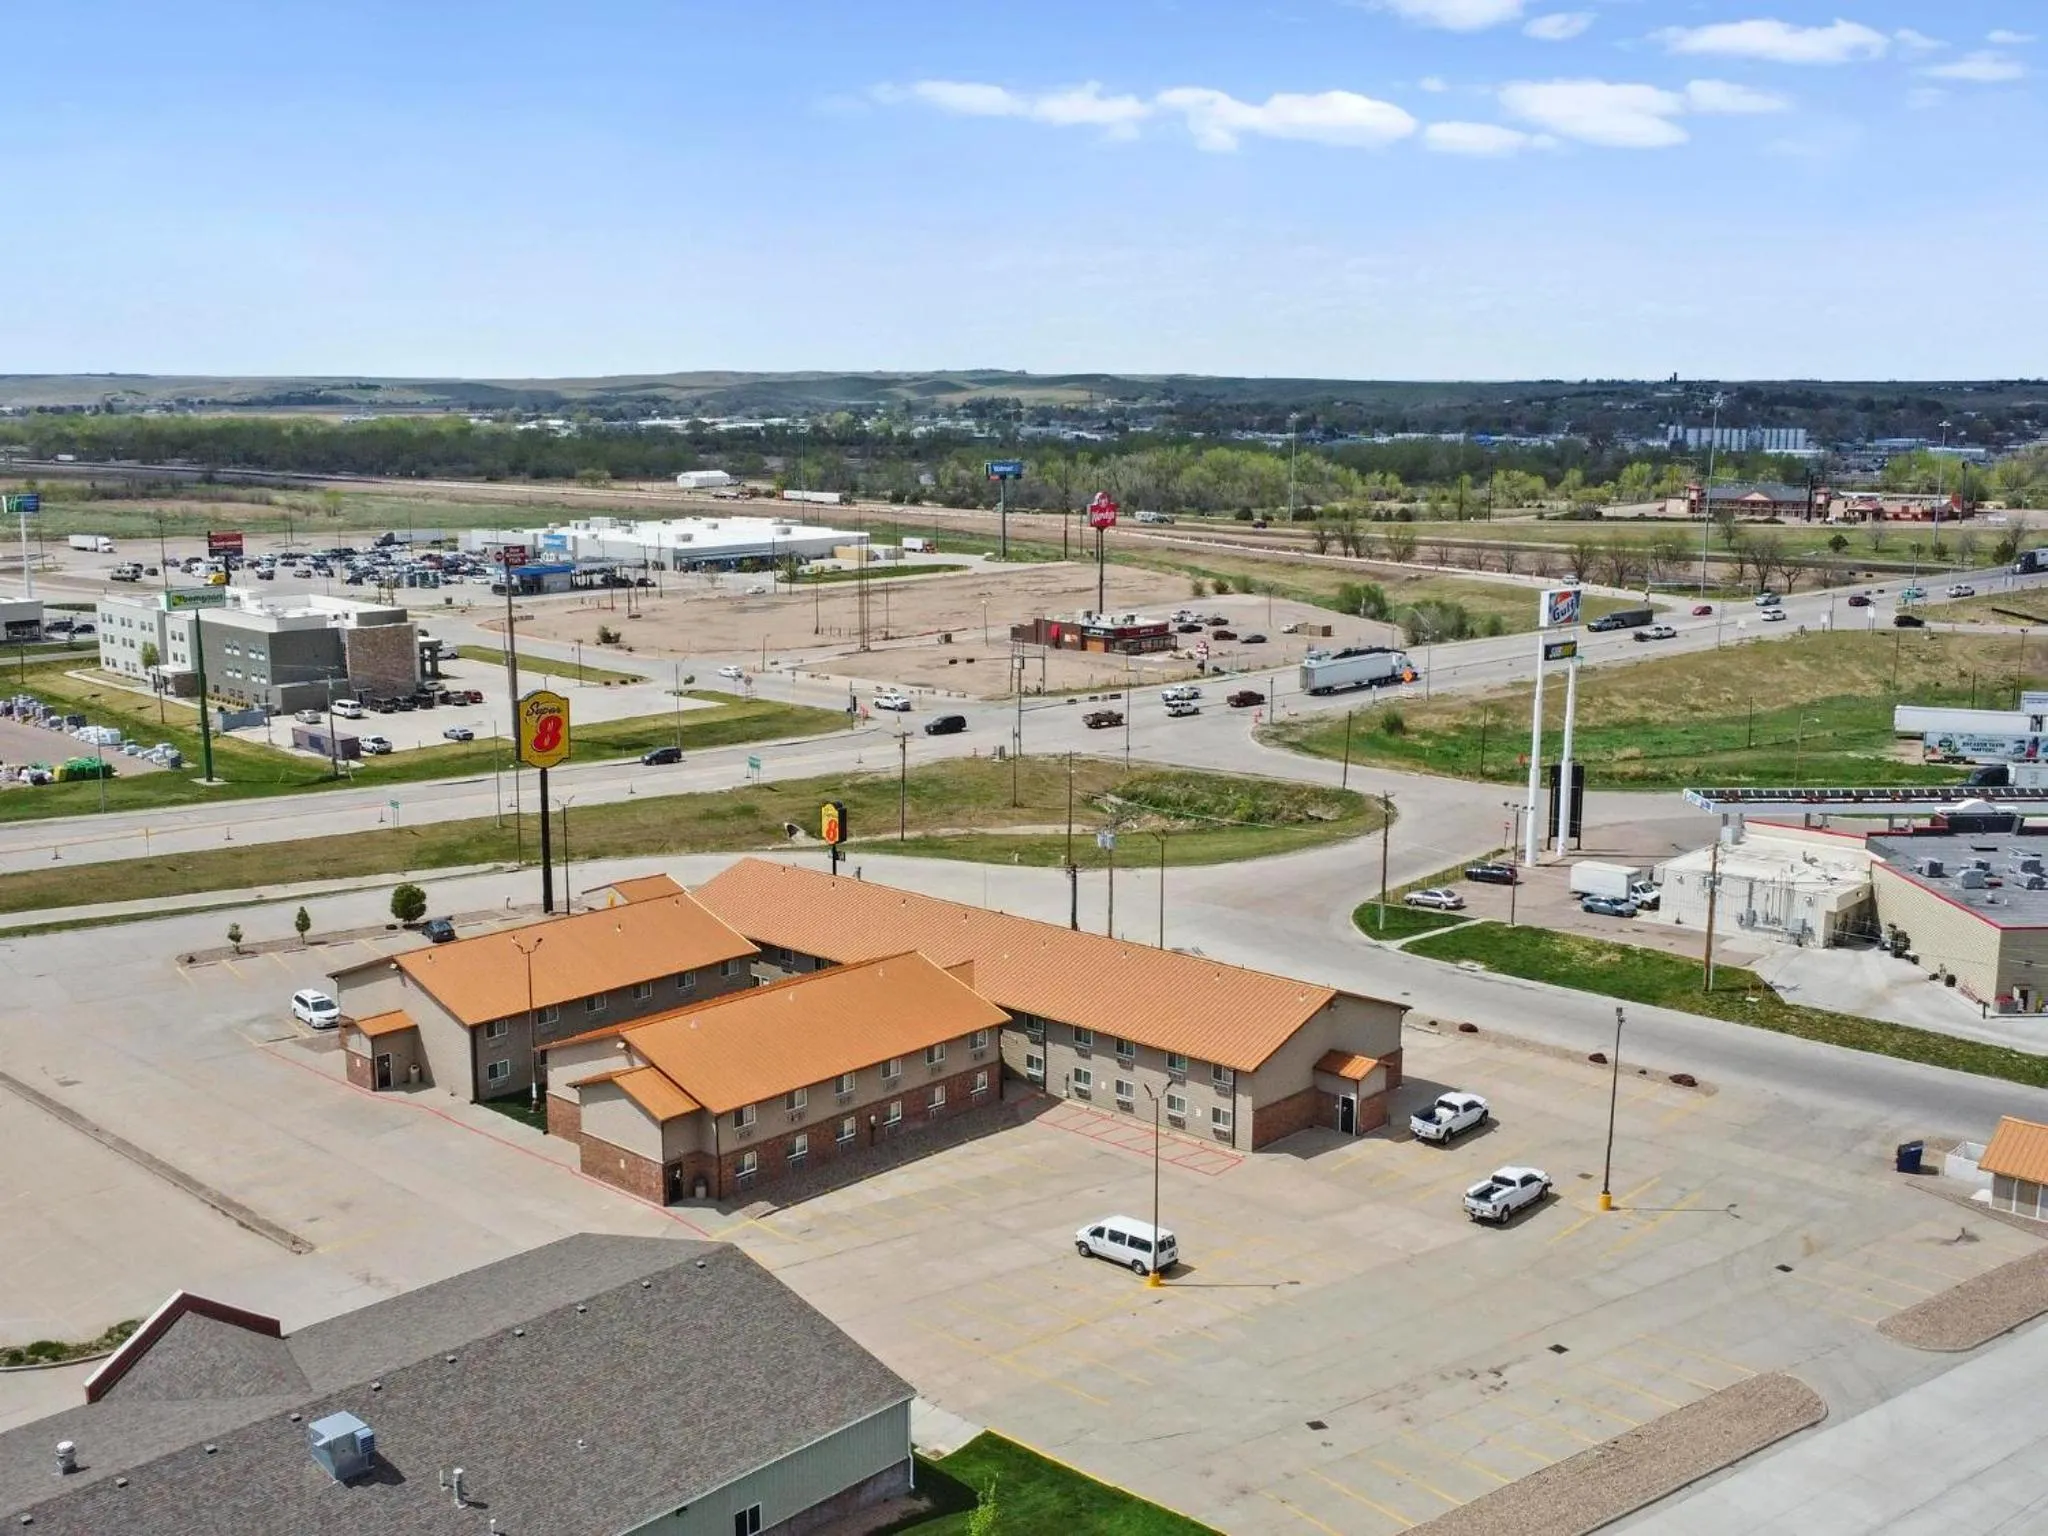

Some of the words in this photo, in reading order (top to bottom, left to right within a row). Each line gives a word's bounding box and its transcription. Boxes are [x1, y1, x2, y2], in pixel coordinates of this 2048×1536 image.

[1552, 598, 1577, 621] Gulf
[526, 701, 561, 722] Super
[532, 714, 563, 753] 8
[826, 818, 838, 842] 8
